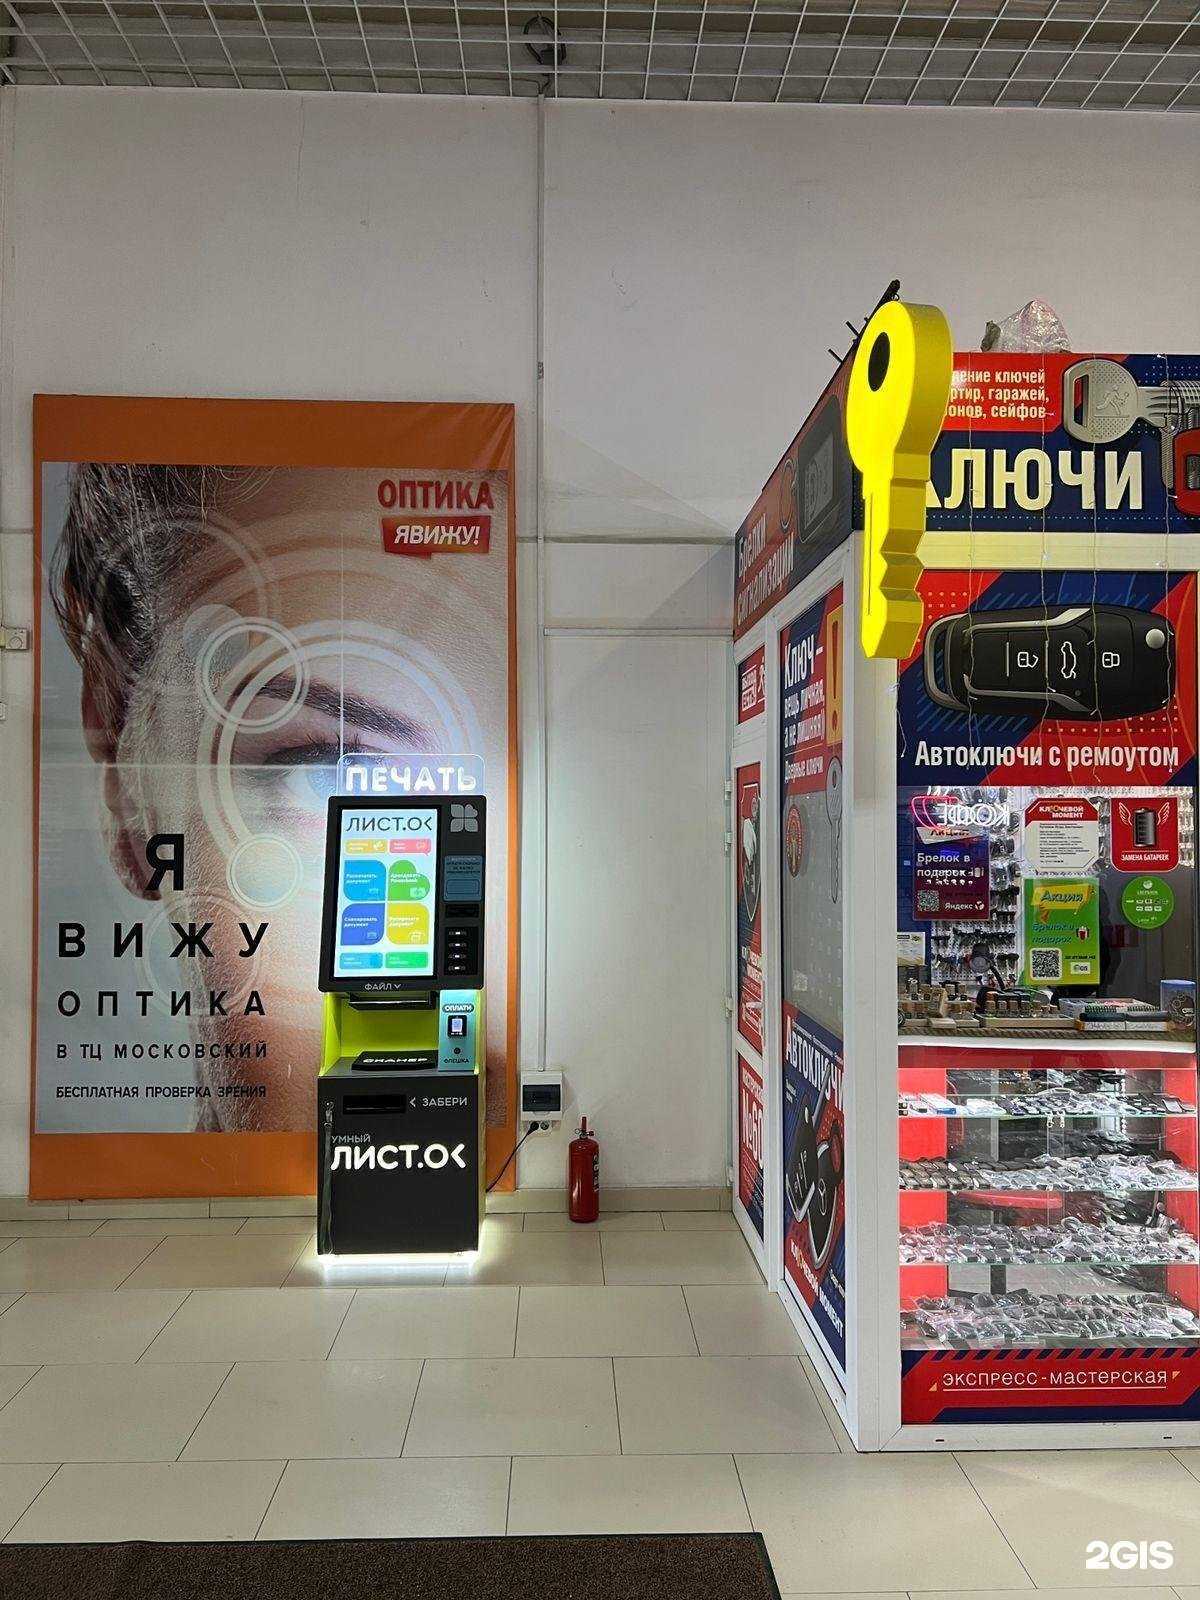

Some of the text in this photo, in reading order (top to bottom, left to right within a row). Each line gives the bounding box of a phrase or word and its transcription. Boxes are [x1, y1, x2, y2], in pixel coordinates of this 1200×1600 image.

[995, 368, 1045, 383] ключей
[950, 386, 1049, 402] ртир, гаражей,
[948, 403, 1046, 420] онов, сейфов
[377, 479, 494, 509] ОПТИКА
[394, 525, 481, 545] ЯВИЖУ!
[914, 740, 1179, 772] Автоключи с ремоутом
[345, 766, 478, 792] ПЕЧАТЬ
[145, 833, 185, 891] Я
[916, 852, 971, 864] Брелок в
[1121, 853, 1142, 861] ЗАМЕНА
[916, 868, 967, 879] подарок
[944, 902, 973, 911] Яндекс
[58, 922, 270, 958] ВИЖУ
[364, 983, 392, 991] ФАЙЛ
[58, 991, 266, 1017] ОПТИКА
[444, 1004, 473, 1012] ОПЛАТИ
[57, 1042, 267, 1060] В ТЦ МОСКОВСКИЙ
[56, 1086, 267, 1099] БЕСПЛАТНАЯ ПРОВЕРКА ЗРЕНИЯ
[422, 1097, 468, 1107] ЗАБЕРИ
[332, 1134, 371, 1143] УМНЫЙ
